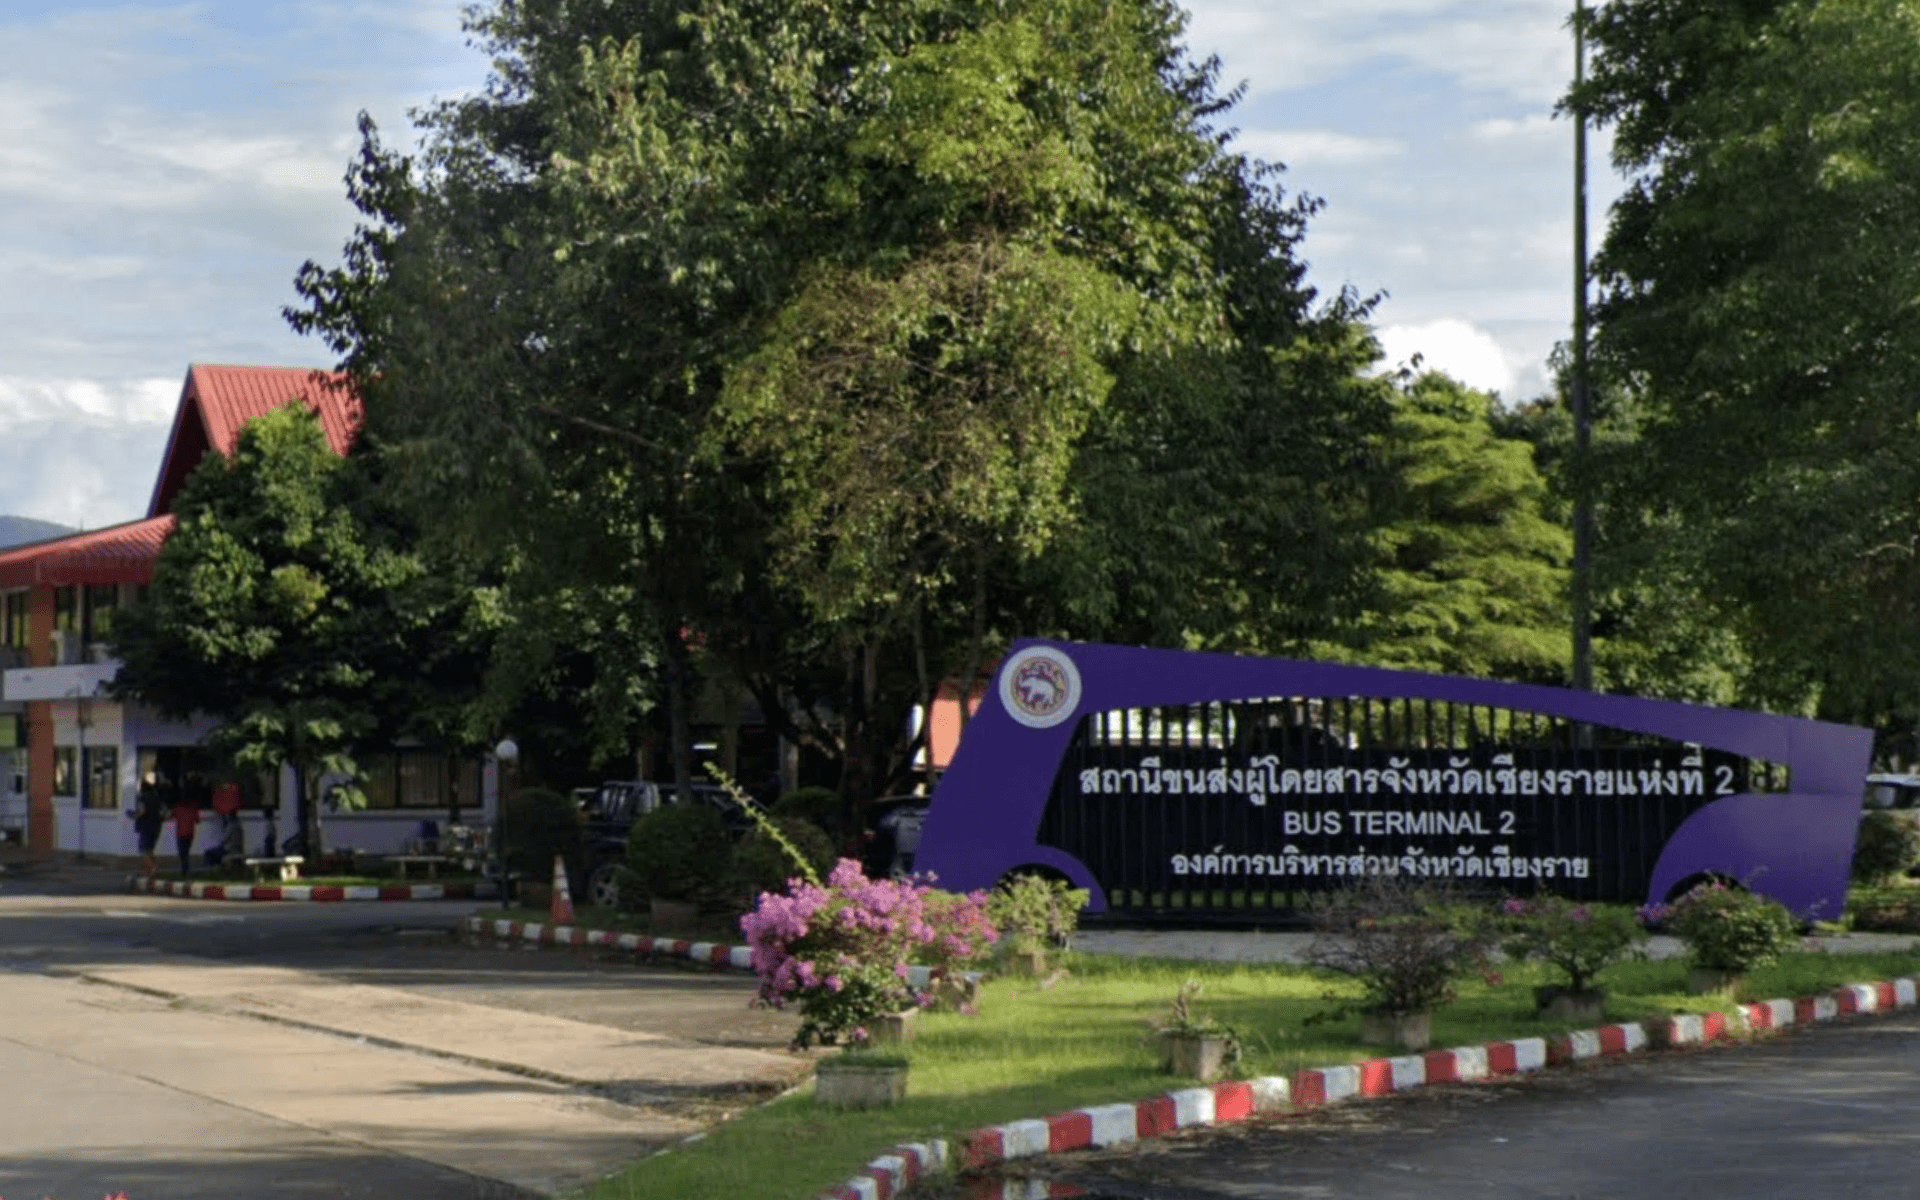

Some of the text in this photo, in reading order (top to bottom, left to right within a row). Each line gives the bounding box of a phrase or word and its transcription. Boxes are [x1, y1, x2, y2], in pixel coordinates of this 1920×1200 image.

[1079, 741, 1735, 806] สถานีขนส่งผู้โดยสารจังหวัดเชียงรายแห่งที่ 2
[1284, 810, 1516, 835] BUS TERMINAL 2
[1170, 844, 1589, 878] องค์การบริหารส่วนจังหวัดเชียงราย
